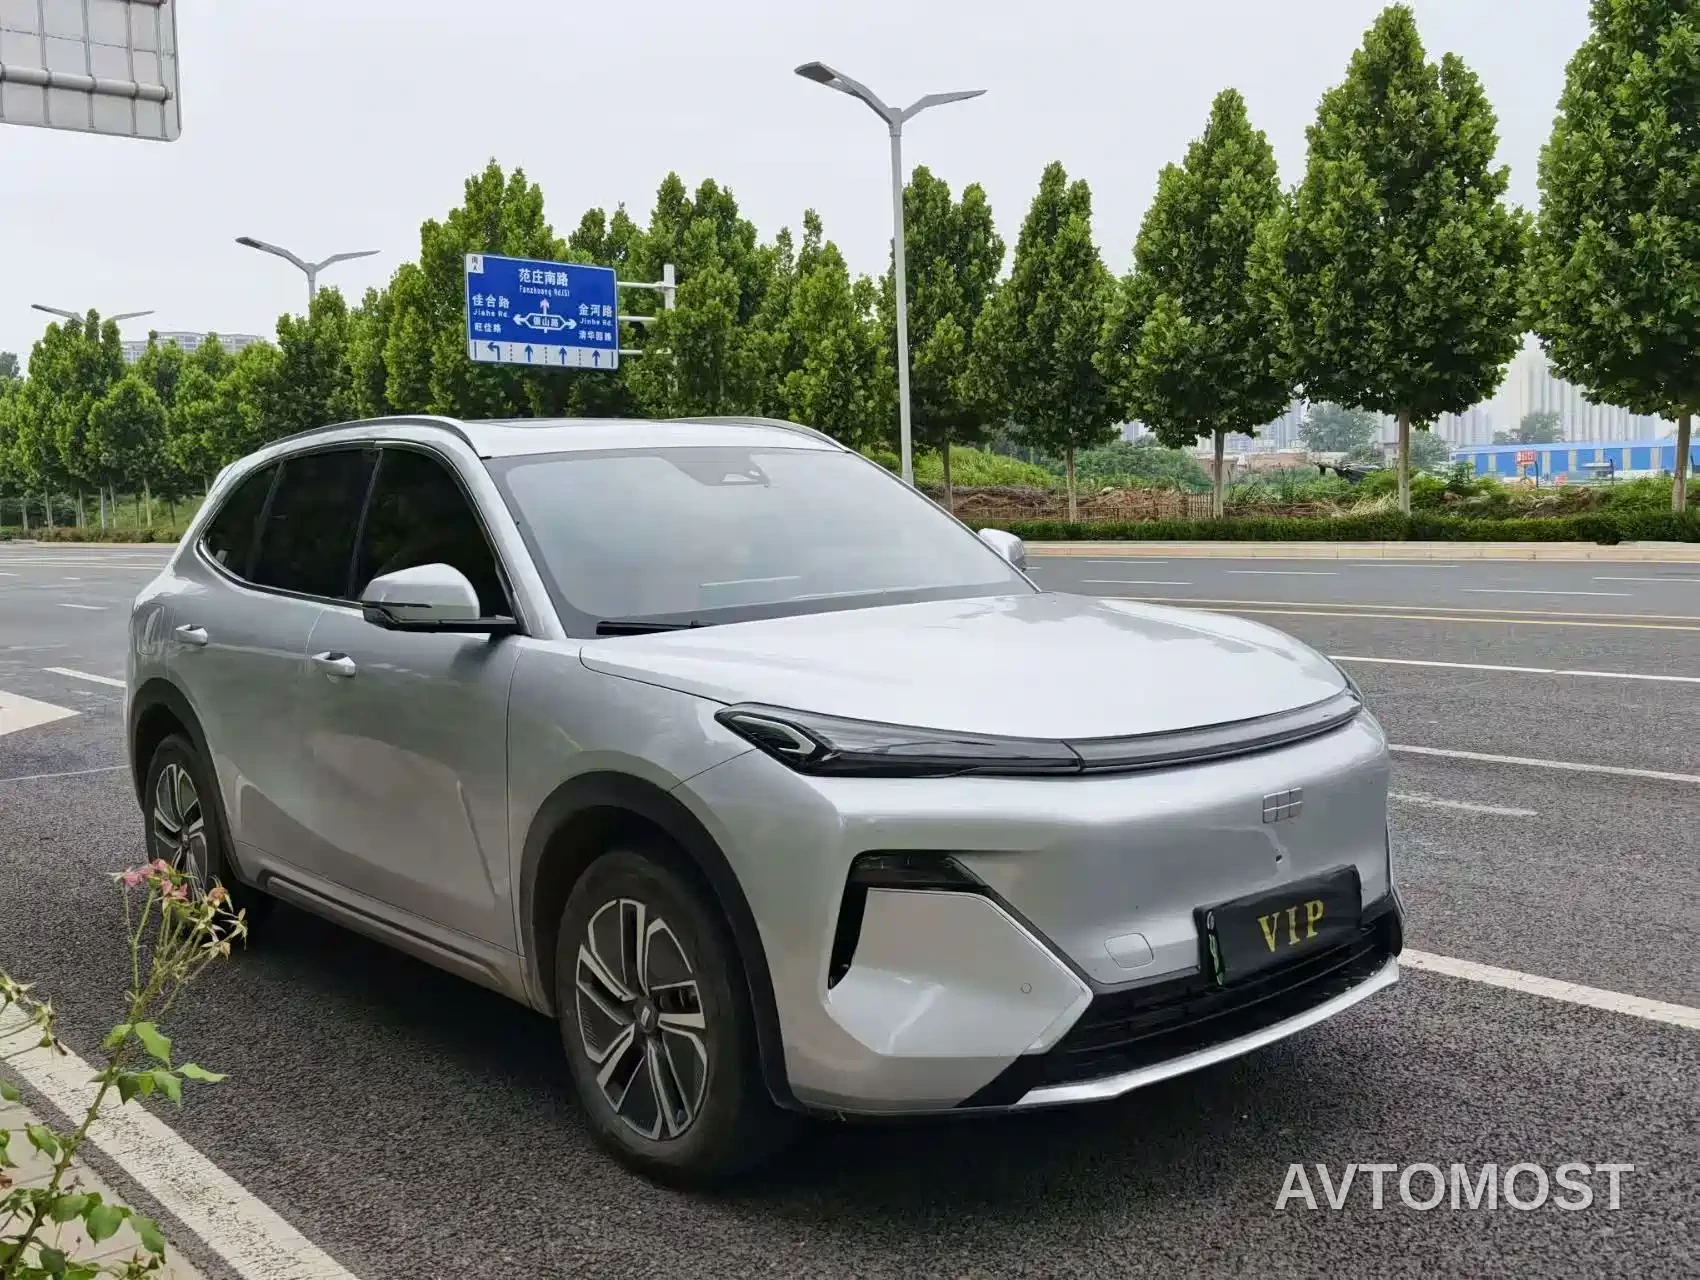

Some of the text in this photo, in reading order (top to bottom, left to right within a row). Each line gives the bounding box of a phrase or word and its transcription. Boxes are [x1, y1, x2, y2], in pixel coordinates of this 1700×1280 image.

[518, 268, 568, 287] 范庄南路
[472, 293, 510, 309] 佳合路
[578, 303, 613, 318] 金河路
[1257, 900, 1324, 952] VIP
